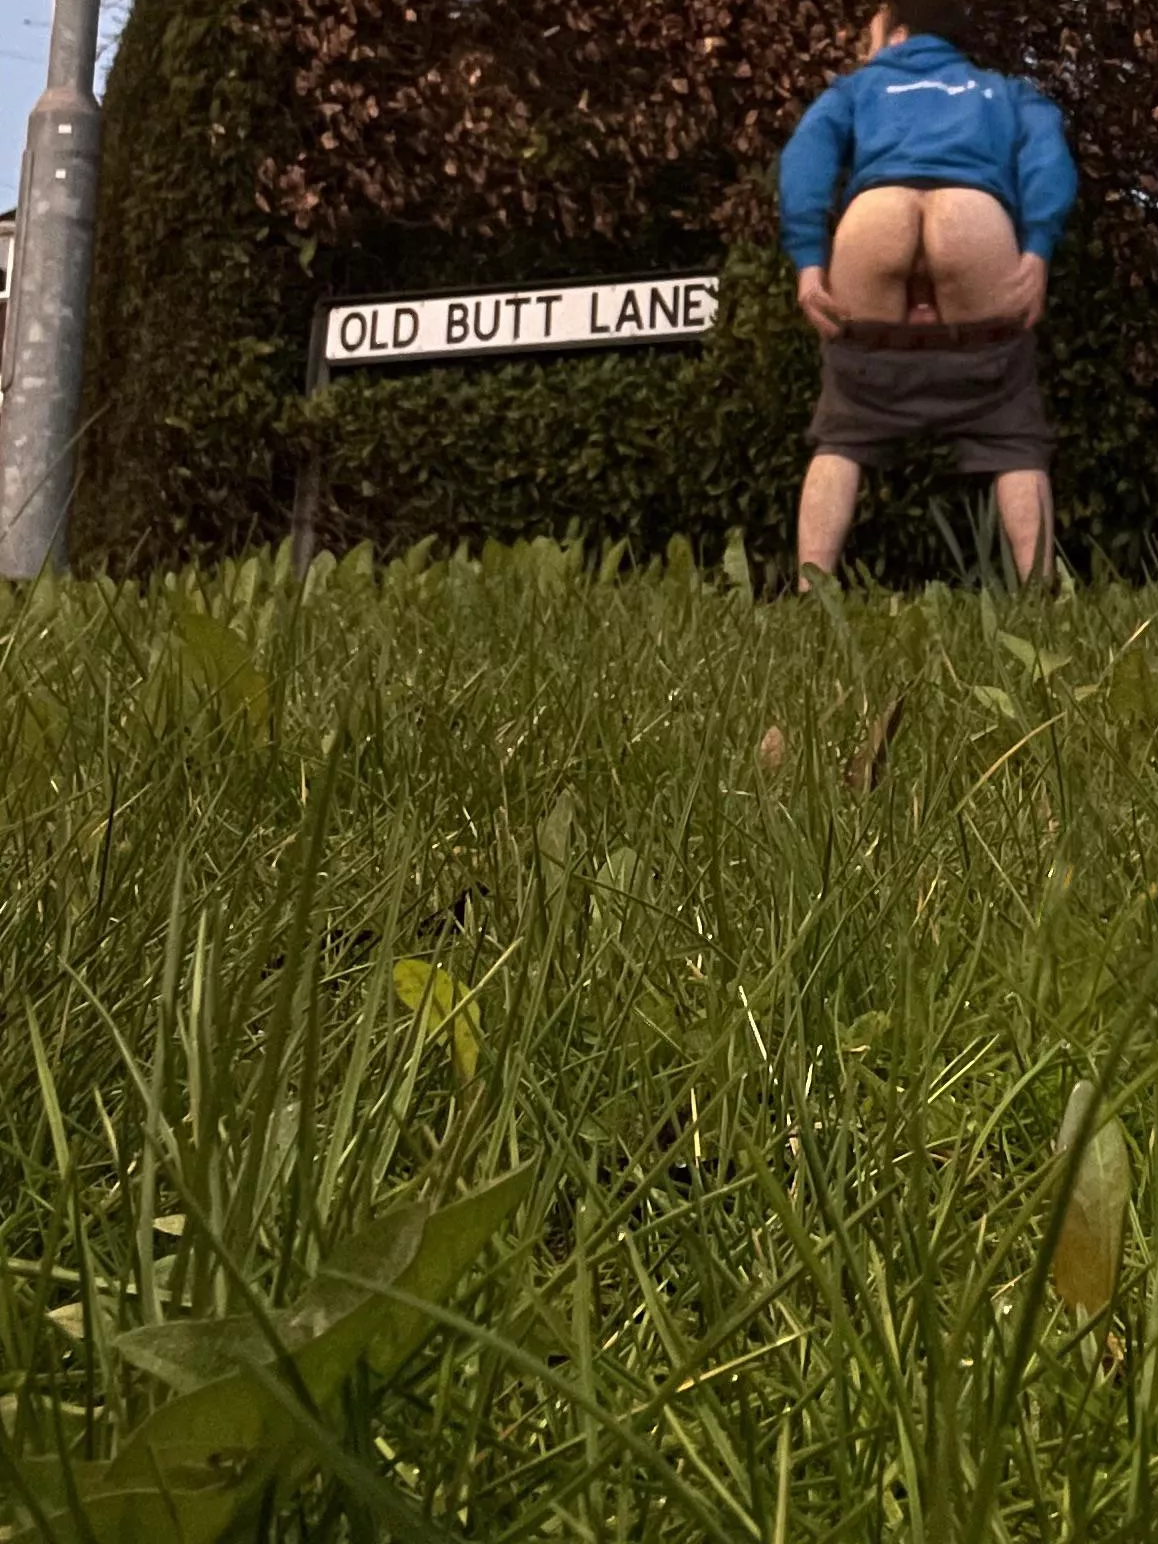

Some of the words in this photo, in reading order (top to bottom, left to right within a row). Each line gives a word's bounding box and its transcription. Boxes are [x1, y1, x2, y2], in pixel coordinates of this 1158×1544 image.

[340, 307, 419, 352] OLD
[446, 294, 562, 343] BUTT
[590, 284, 705, 333] LANE
